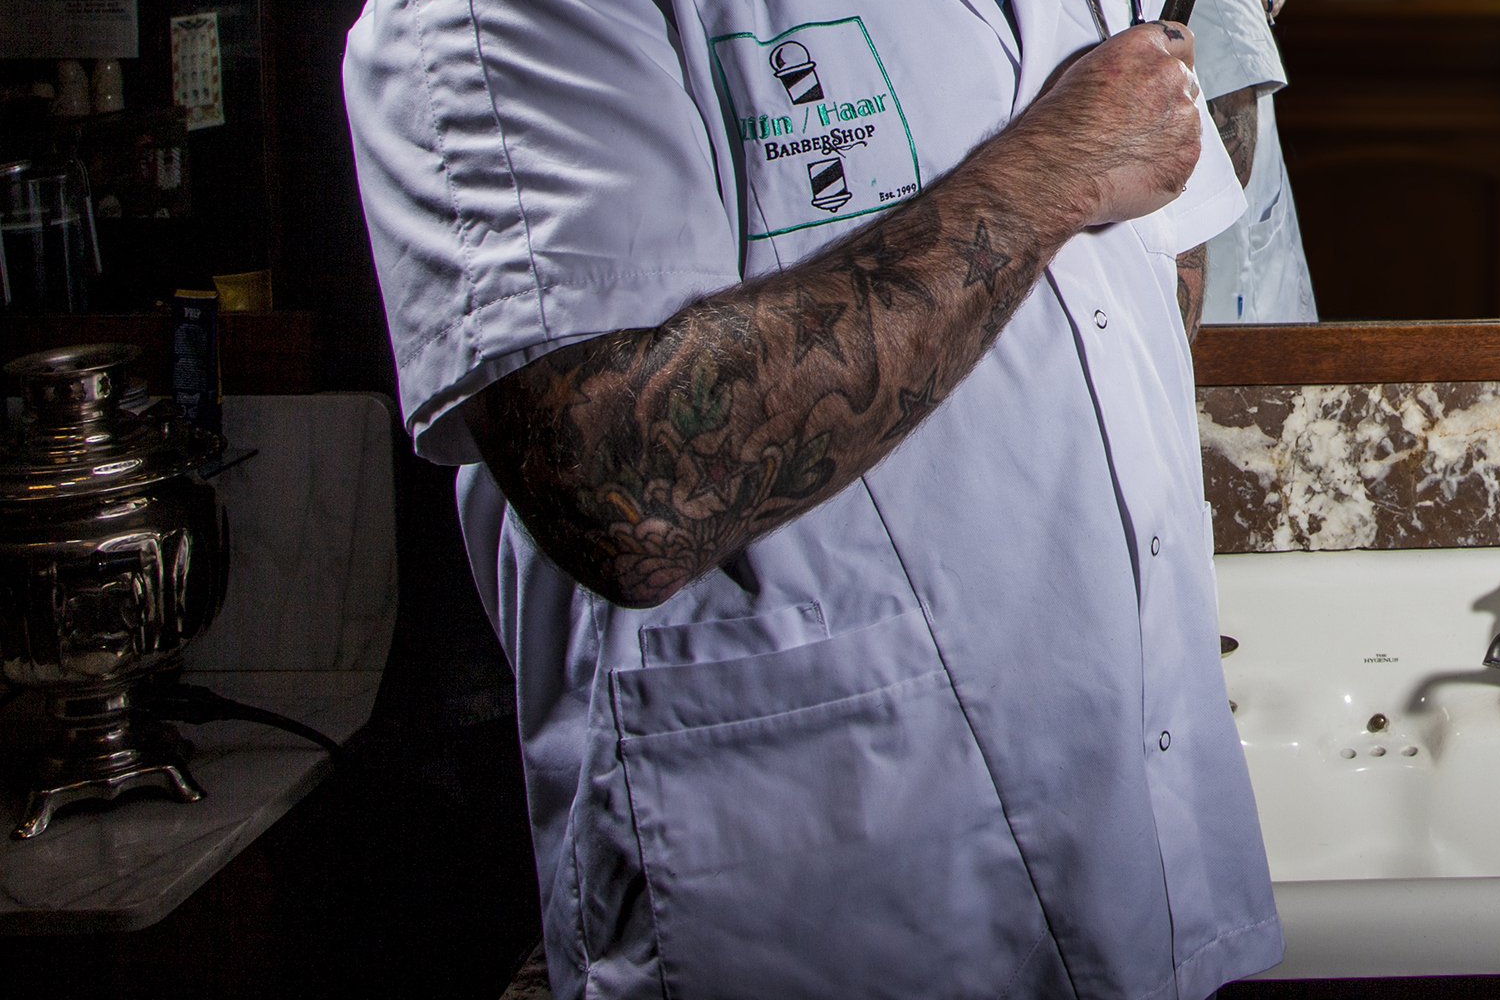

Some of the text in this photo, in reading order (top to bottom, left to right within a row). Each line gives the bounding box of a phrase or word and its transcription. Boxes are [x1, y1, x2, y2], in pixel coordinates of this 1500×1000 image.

[816, 93, 888, 127] Haar
[878, 182, 918, 203] Est. 1999
